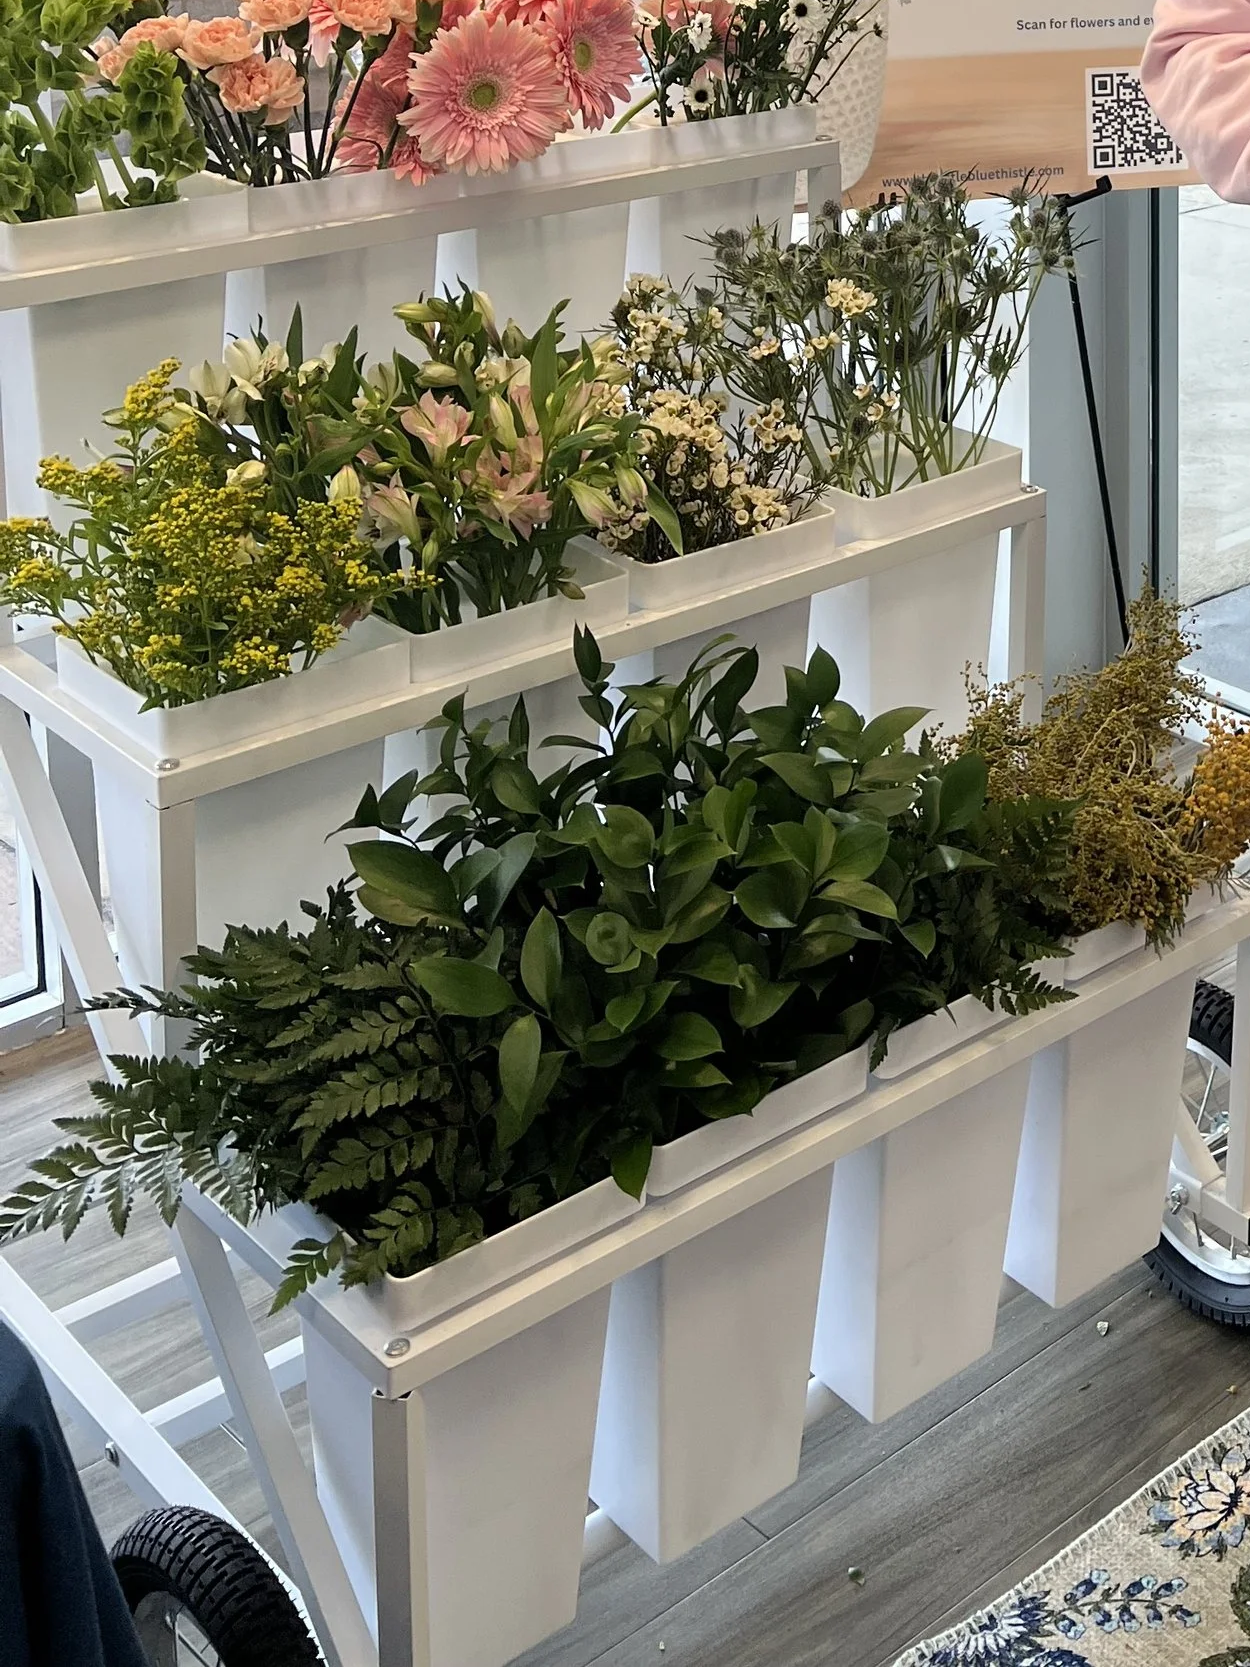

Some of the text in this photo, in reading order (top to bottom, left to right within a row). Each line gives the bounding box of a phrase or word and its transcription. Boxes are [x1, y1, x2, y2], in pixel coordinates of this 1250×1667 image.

[1016, 19, 1047, 31] Scan
[1049, 17, 1068, 29] for
[1070, 16, 1115, 29] flowers
[1118, 15, 1140, 26] and
